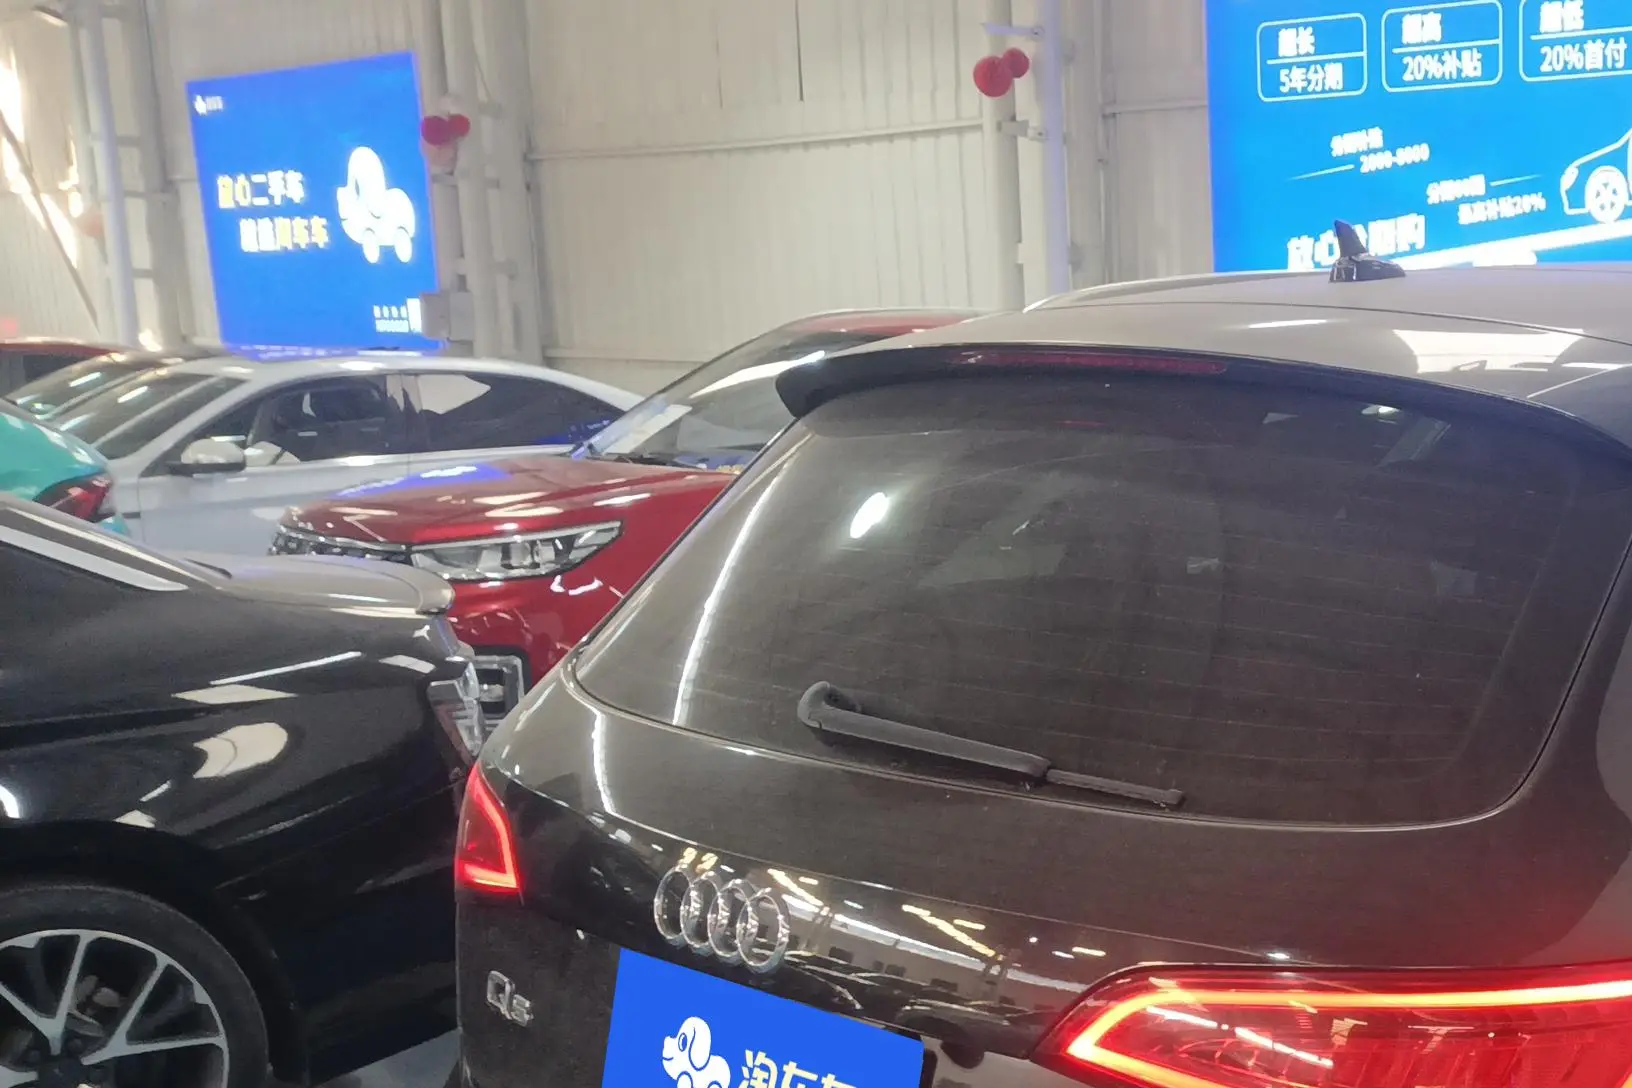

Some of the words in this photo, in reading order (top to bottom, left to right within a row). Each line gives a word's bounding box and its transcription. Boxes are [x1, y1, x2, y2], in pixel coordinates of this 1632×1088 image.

[1402, 48, 1482, 82] 20%补贴
[1539, 37, 1627, 72] 20%首付
[1279, 62, 1343, 93] 5年分期
[486, 969, 534, 1027] Q5
